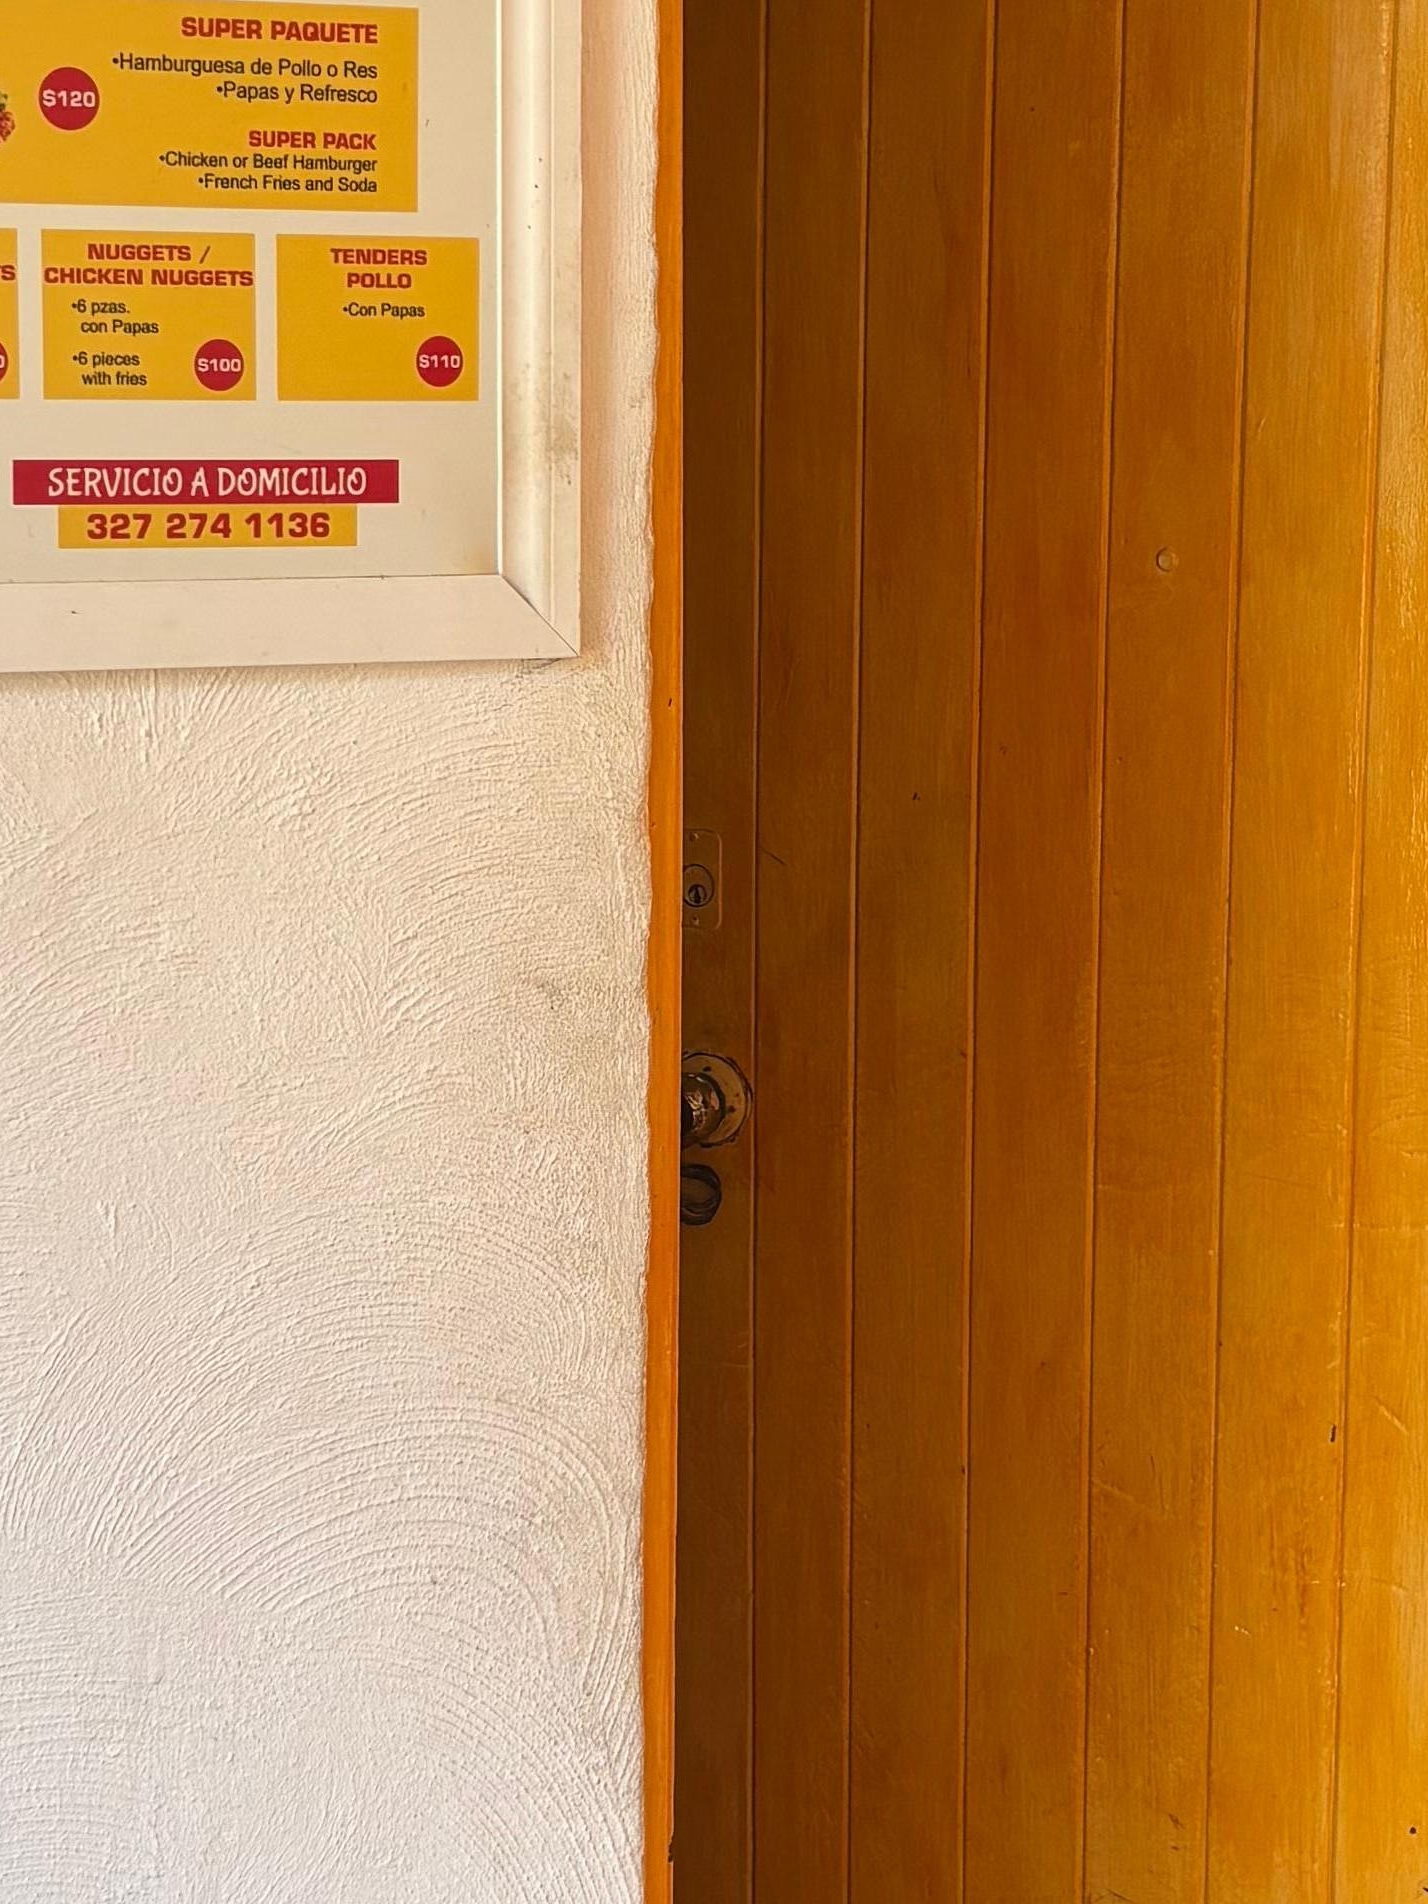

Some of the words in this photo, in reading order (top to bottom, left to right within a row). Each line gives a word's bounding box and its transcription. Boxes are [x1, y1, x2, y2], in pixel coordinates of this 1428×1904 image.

[181, 16, 262, 39] SUPER
[270, 20, 378, 44] PAQUETE
[250, 57, 272, 75] de
[278, 57, 321, 77] Pollo
[326, 63, 338, 77] o
[343, 60, 377, 79] Res
[42, 89, 96, 107] $120
[248, 130, 316, 149] SUPER
[322, 132, 376, 150] PACK
[330, 248, 427, 265] TENDERS
[346, 272, 412, 289] POLLO
[197, 357, 241, 372] $100
[418, 354, 460, 368] $110
[48, 467, 182, 497] SERVICIO
[190, 467, 209, 497] A
[217, 467, 366, 496] DOMICILIO
[87, 513, 152, 539] 327
[166, 512, 232, 539] 274
[244, 511, 330, 538] 1136
